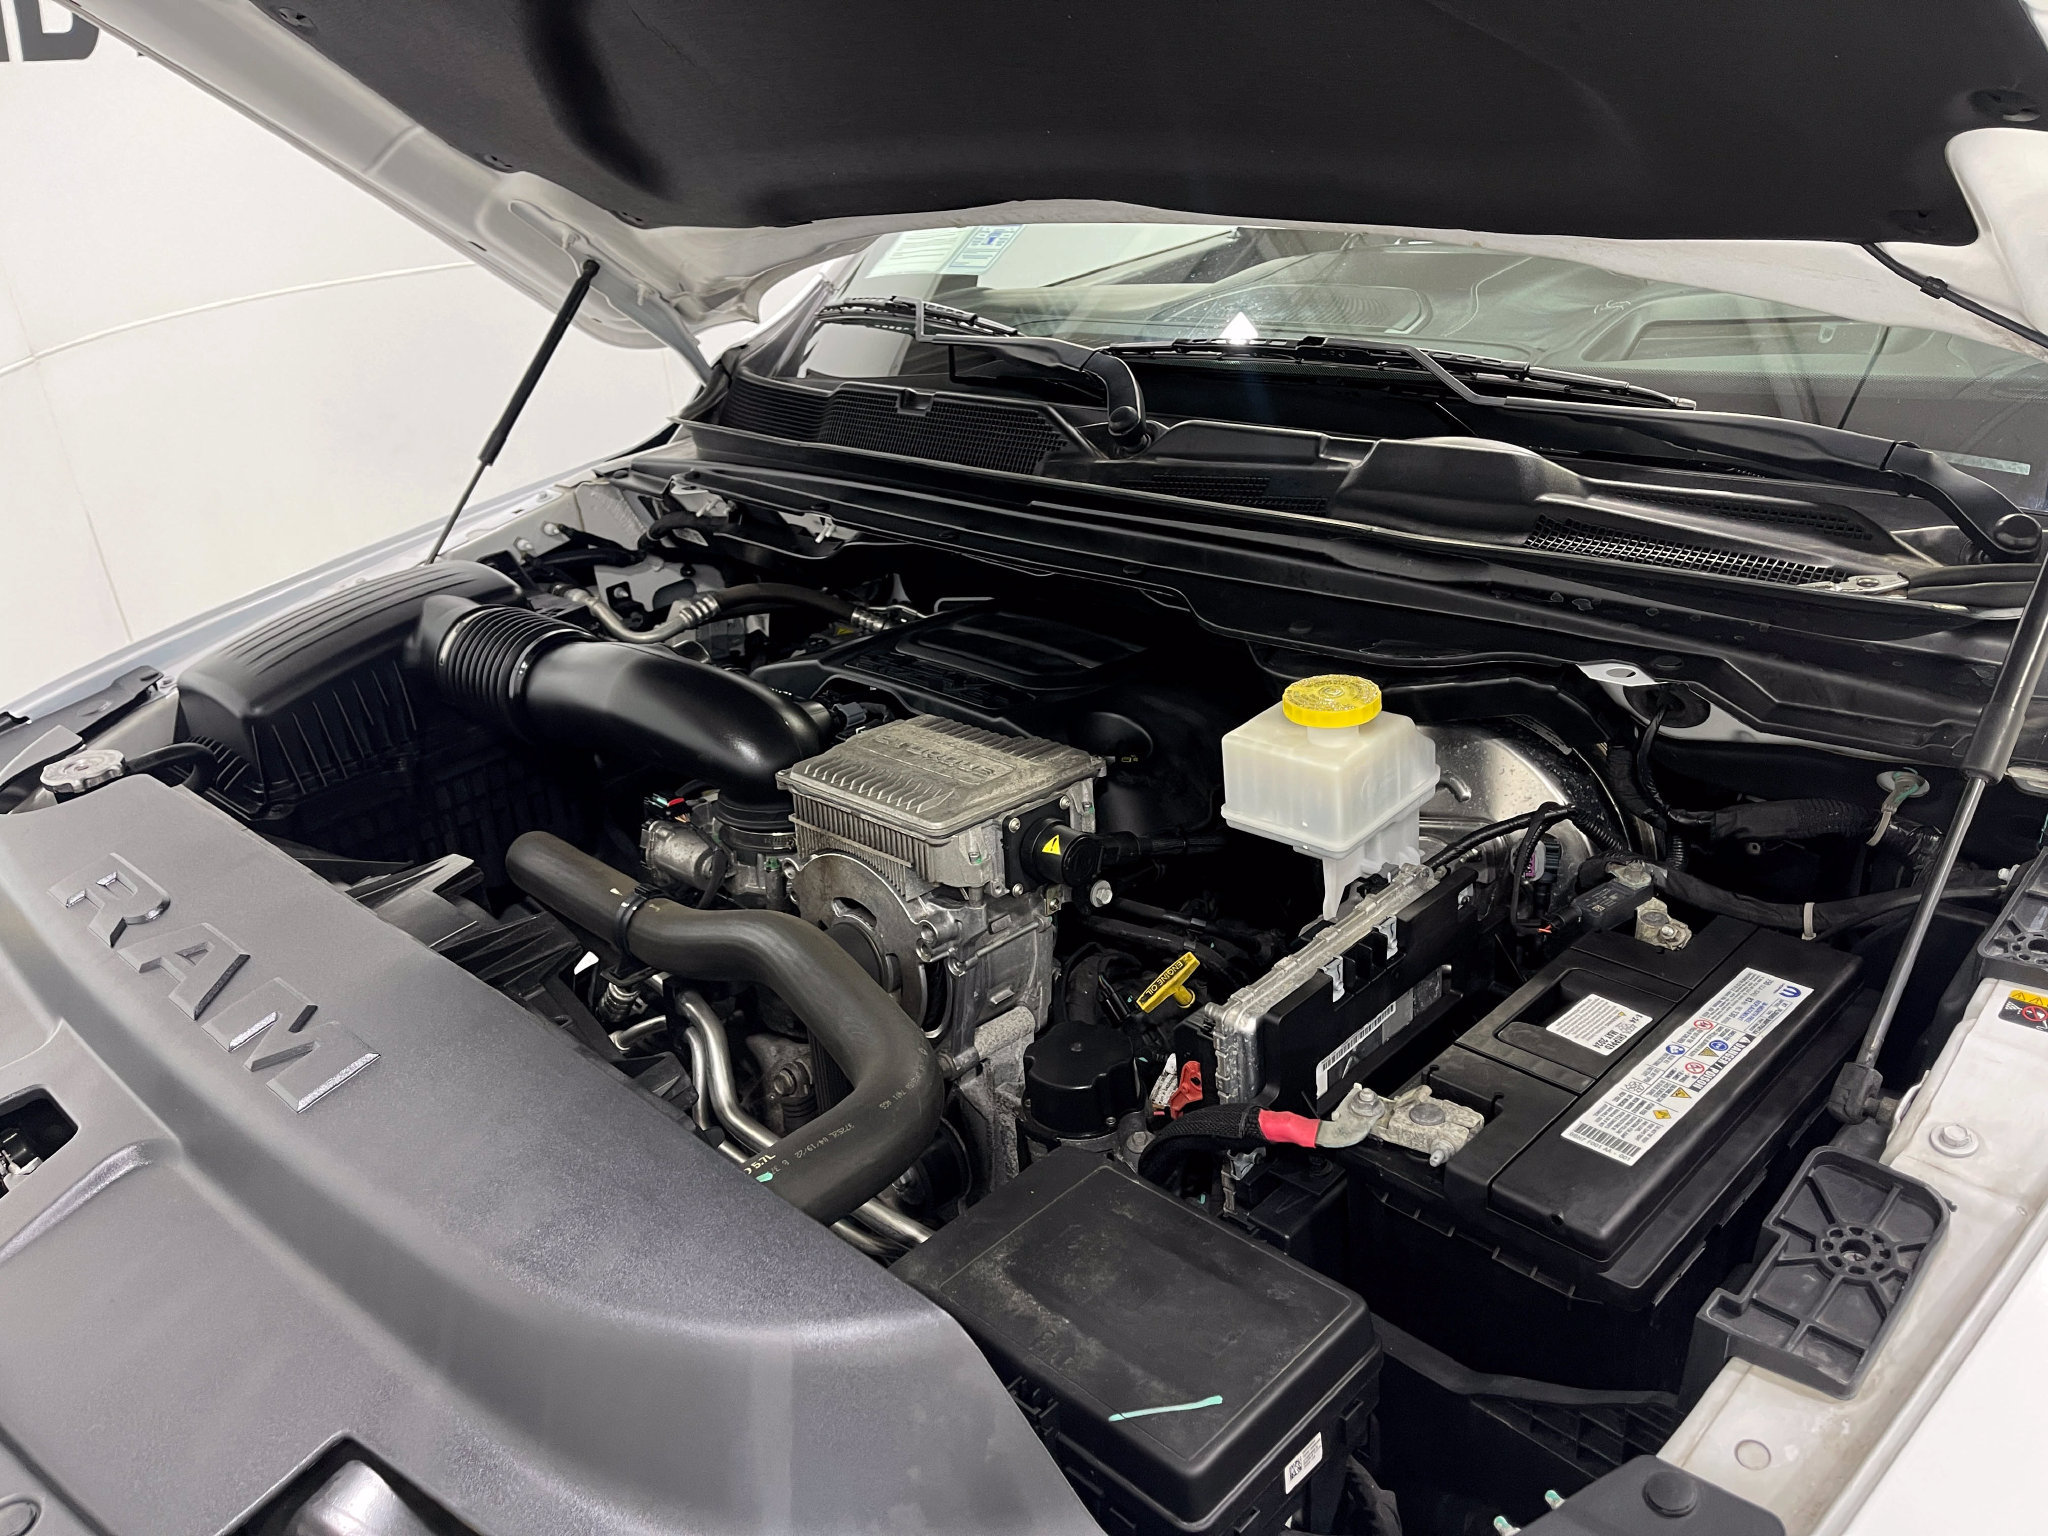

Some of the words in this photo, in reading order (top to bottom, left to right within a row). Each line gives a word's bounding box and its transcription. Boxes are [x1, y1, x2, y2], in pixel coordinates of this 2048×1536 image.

[1156, 960, 1184, 986] ENGINE
[47, 852, 381, 1114] RAM
[1145, 983, 1158, 996] OIL
[1592, 1037, 1609, 1049] 2024
[1604, 1029, 1620, 1039] MAY
[1604, 1033, 1628, 1050] SHIPPED
[1718, 1042, 1746, 1065] DANGER
[1692, 1066, 1720, 1090] POISON
[751, 1152, 776, 1170] 5.7L
